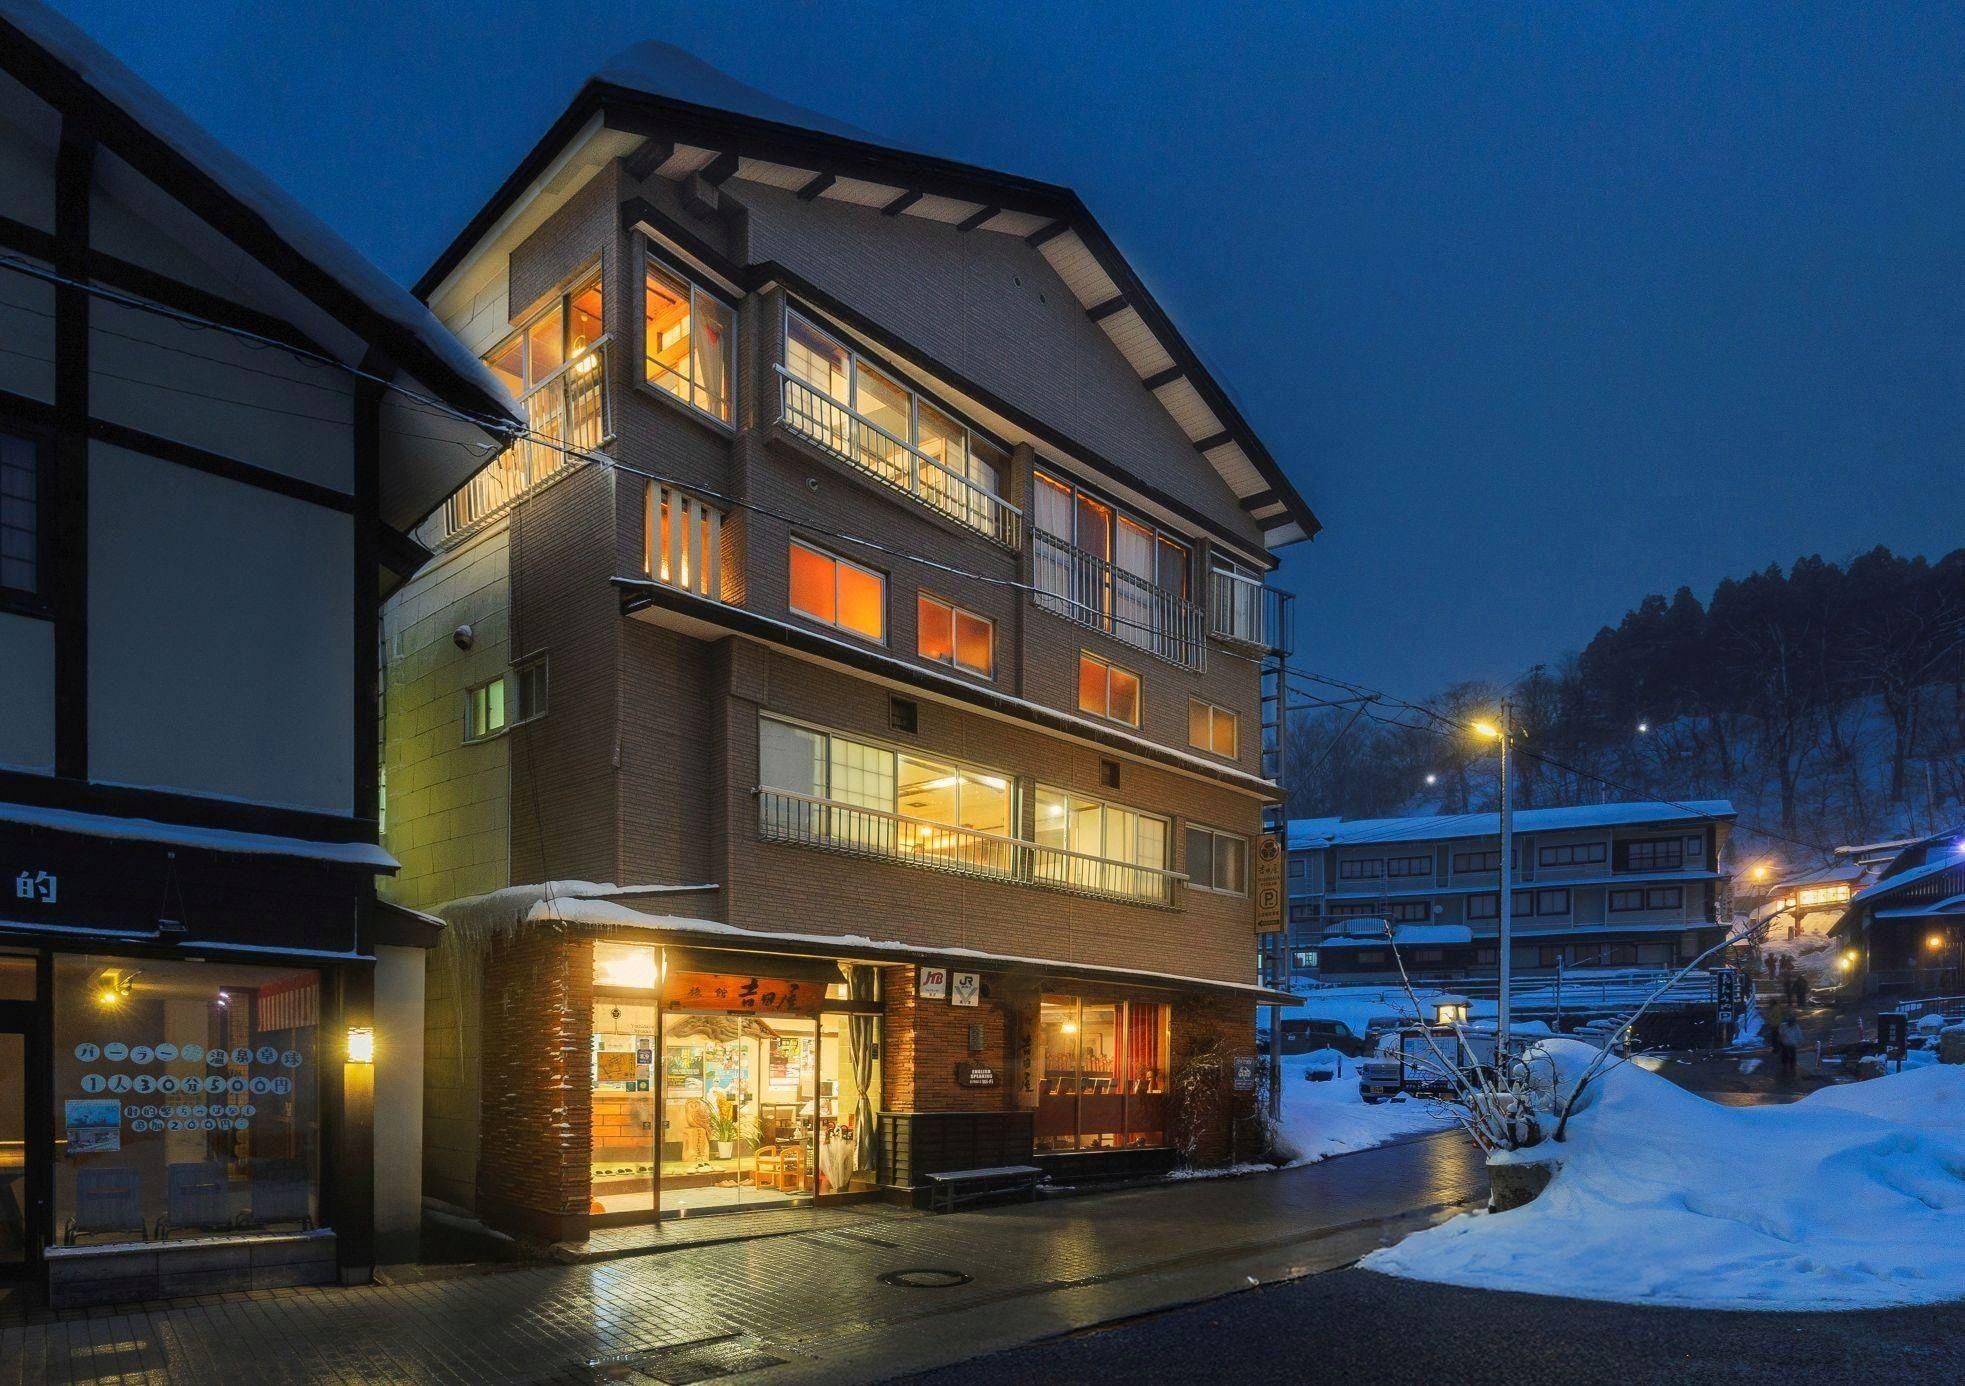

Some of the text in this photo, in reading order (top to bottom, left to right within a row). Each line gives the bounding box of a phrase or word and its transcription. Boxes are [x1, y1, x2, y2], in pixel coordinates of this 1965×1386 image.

[16, 870, 57, 903] 的
[923, 971, 943, 985] JTB
[959, 976, 973, 986] JR
[687, 977, 801, 1011] 旅館 吉田屋
[87, 1075, 290, 1093] 1人30分500円
